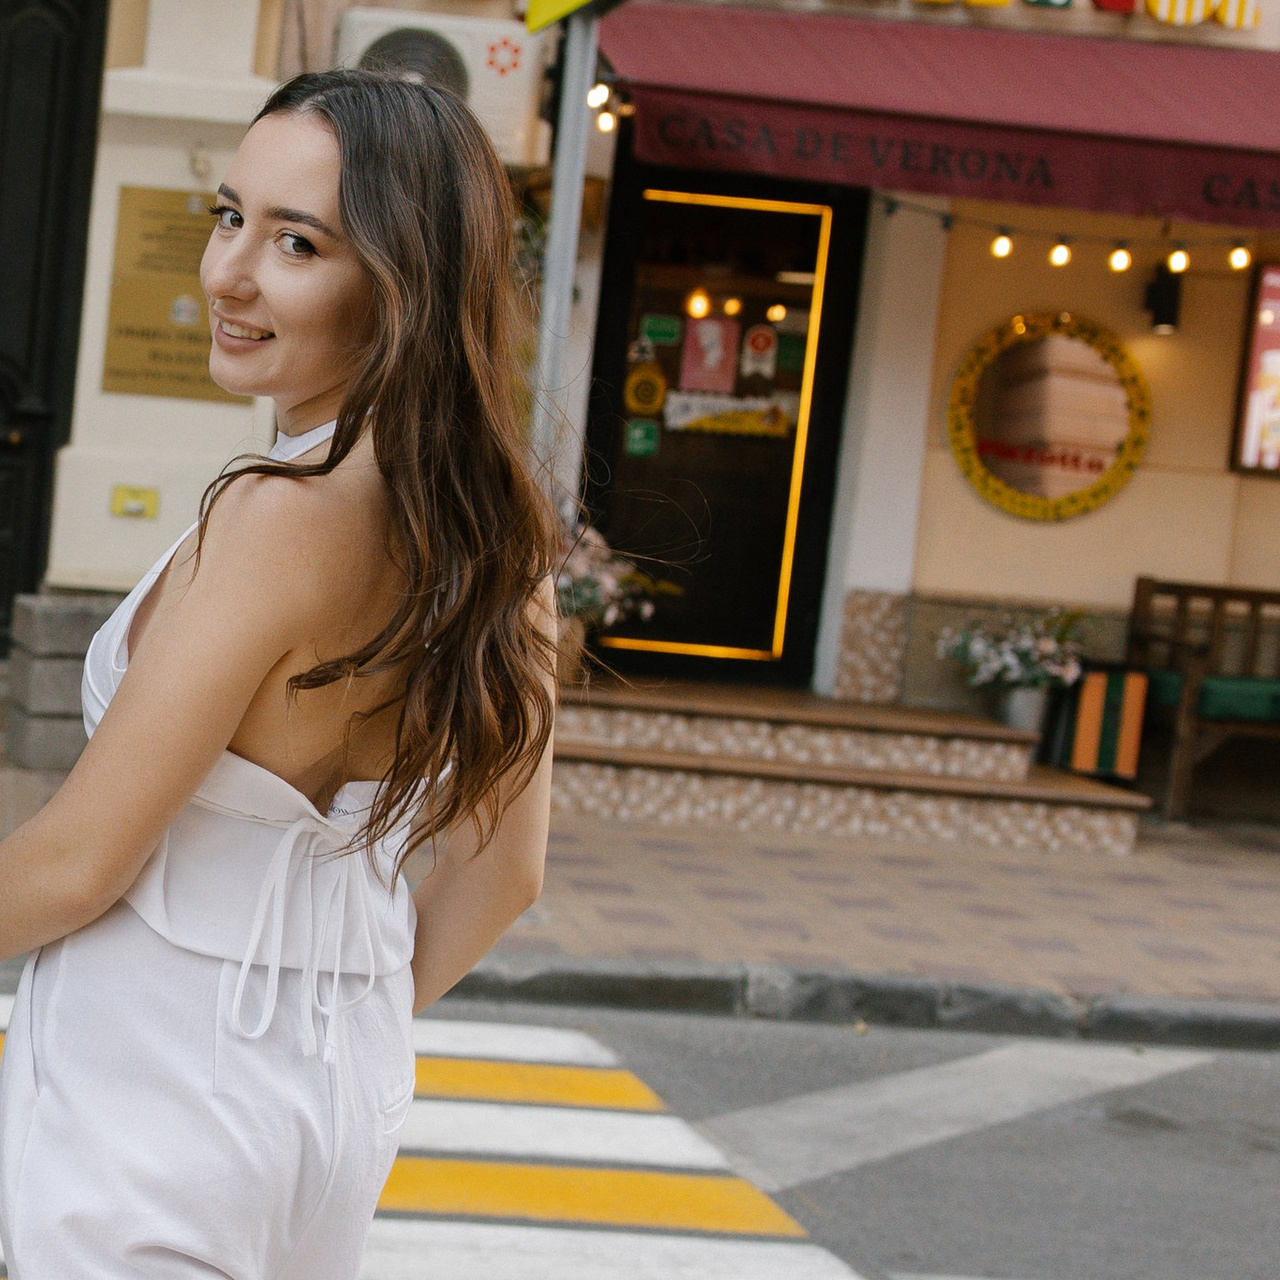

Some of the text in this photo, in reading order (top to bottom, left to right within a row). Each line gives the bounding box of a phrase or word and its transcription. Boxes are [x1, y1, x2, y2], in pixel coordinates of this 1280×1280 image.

[657, 113, 1055, 189] CASA DE VERONA
